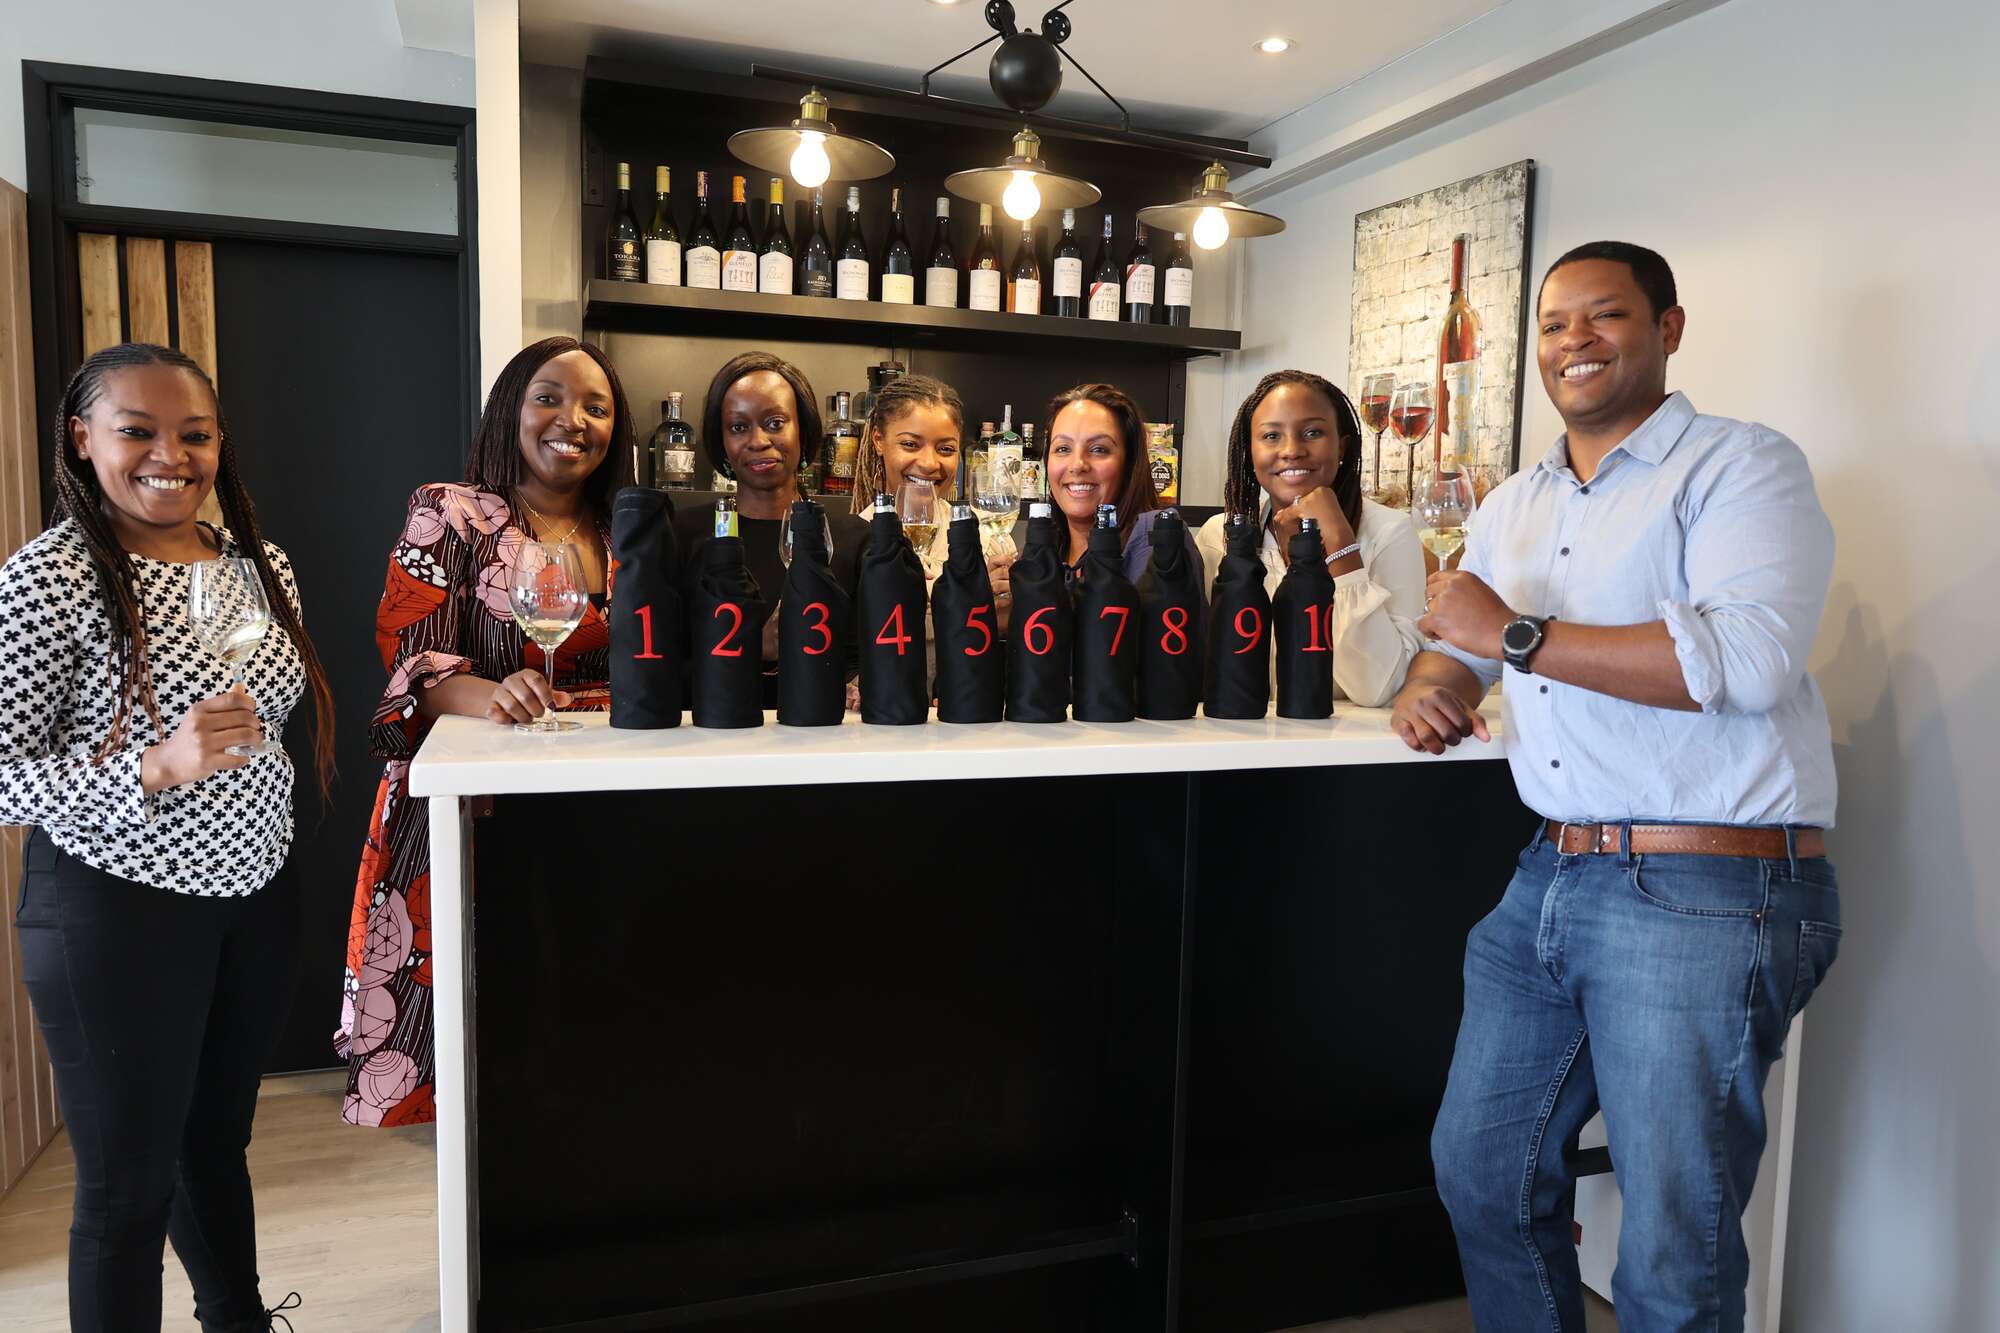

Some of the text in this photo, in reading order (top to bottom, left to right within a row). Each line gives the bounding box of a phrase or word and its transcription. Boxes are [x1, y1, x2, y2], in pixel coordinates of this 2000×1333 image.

[833, 463, 852, 475] GIN
[633, 604, 664, 660] 1
[711, 602, 744, 657] 2
[802, 602, 833, 656] 3
[875, 604, 912, 656] 4
[964, 604, 992, 656] 5
[1023, 607, 1057, 656] 6
[1100, 606, 1130, 657] 7
[1160, 607, 1189, 655] 8
[1234, 607, 1263, 655] 9
